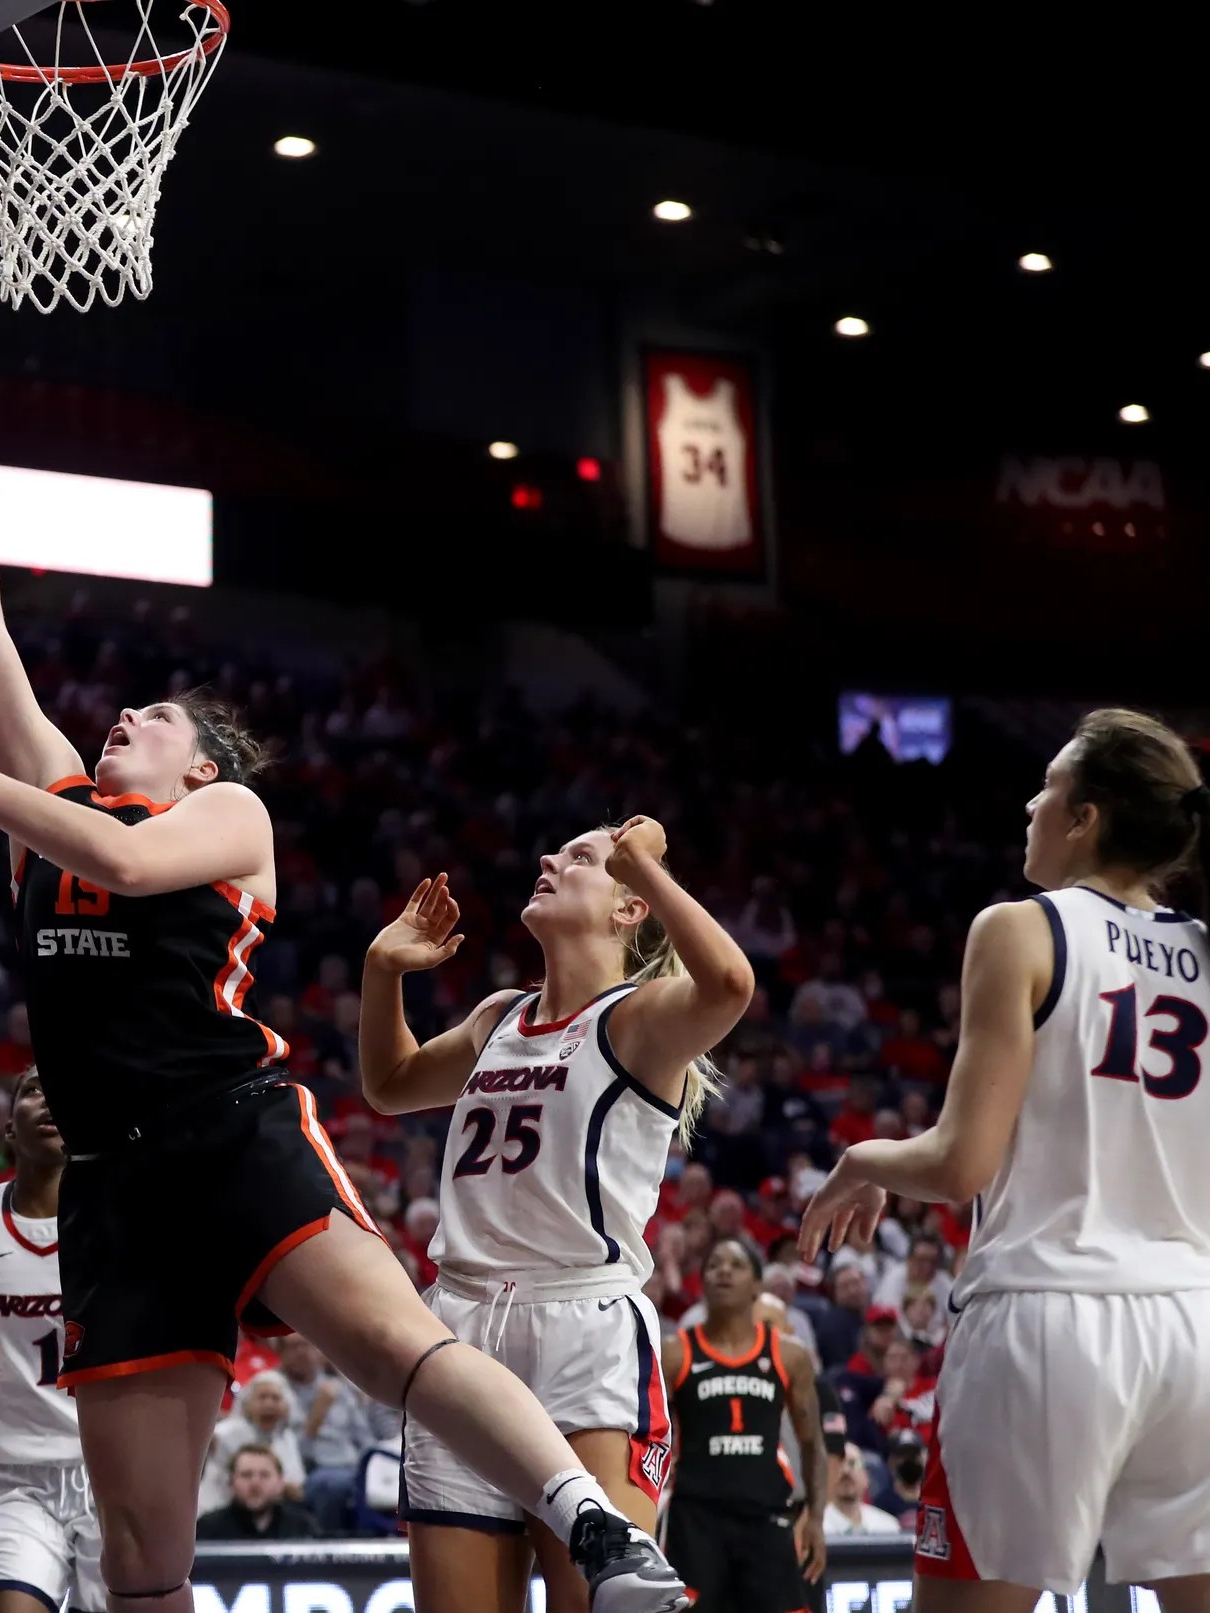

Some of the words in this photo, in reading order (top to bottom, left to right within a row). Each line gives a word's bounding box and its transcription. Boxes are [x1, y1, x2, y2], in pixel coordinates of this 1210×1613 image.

[680, 444, 727, 489] 34
[995, 453, 1165, 511] NCAA
[36, 928, 131, 957] STATE
[1105, 919, 1200, 983] PUEYO
[1090, 983, 1208, 1100] 13
[461, 1065, 569, 1095] ARIZONA
[452, 1104, 543, 1180] 25
[32, 1328, 60, 1386] 1
[697, 1375, 776, 1402] OREGON
[730, 1397, 744, 1434] 1
[708, 1434, 764, 1457] STATE
